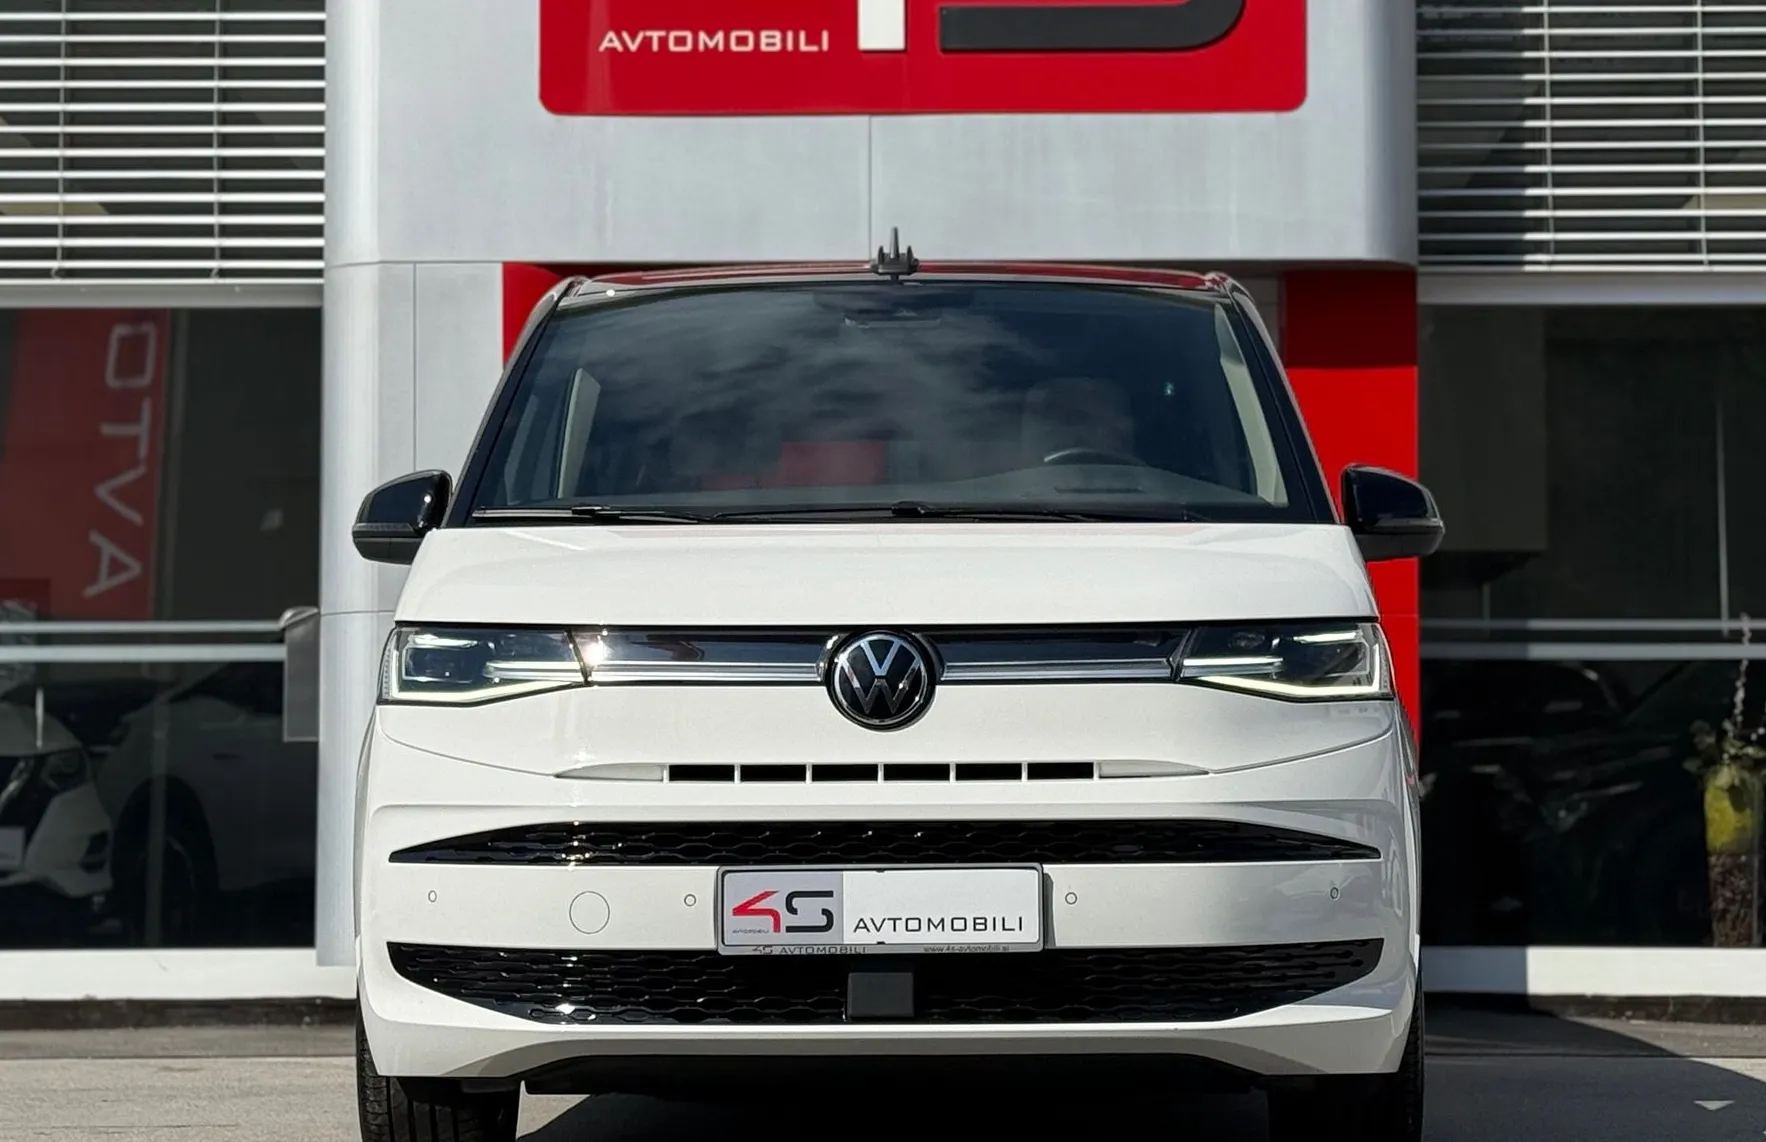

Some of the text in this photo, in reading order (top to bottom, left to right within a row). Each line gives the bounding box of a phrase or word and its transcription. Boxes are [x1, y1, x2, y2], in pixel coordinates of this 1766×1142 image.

[599, 30, 829, 52] AVTOMOBILI
[836, 634, 926, 720] VW
[732, 890, 1023, 933] 4S AVTOMOBILI
[779, 946, 867, 955] AVTOMOBILI
